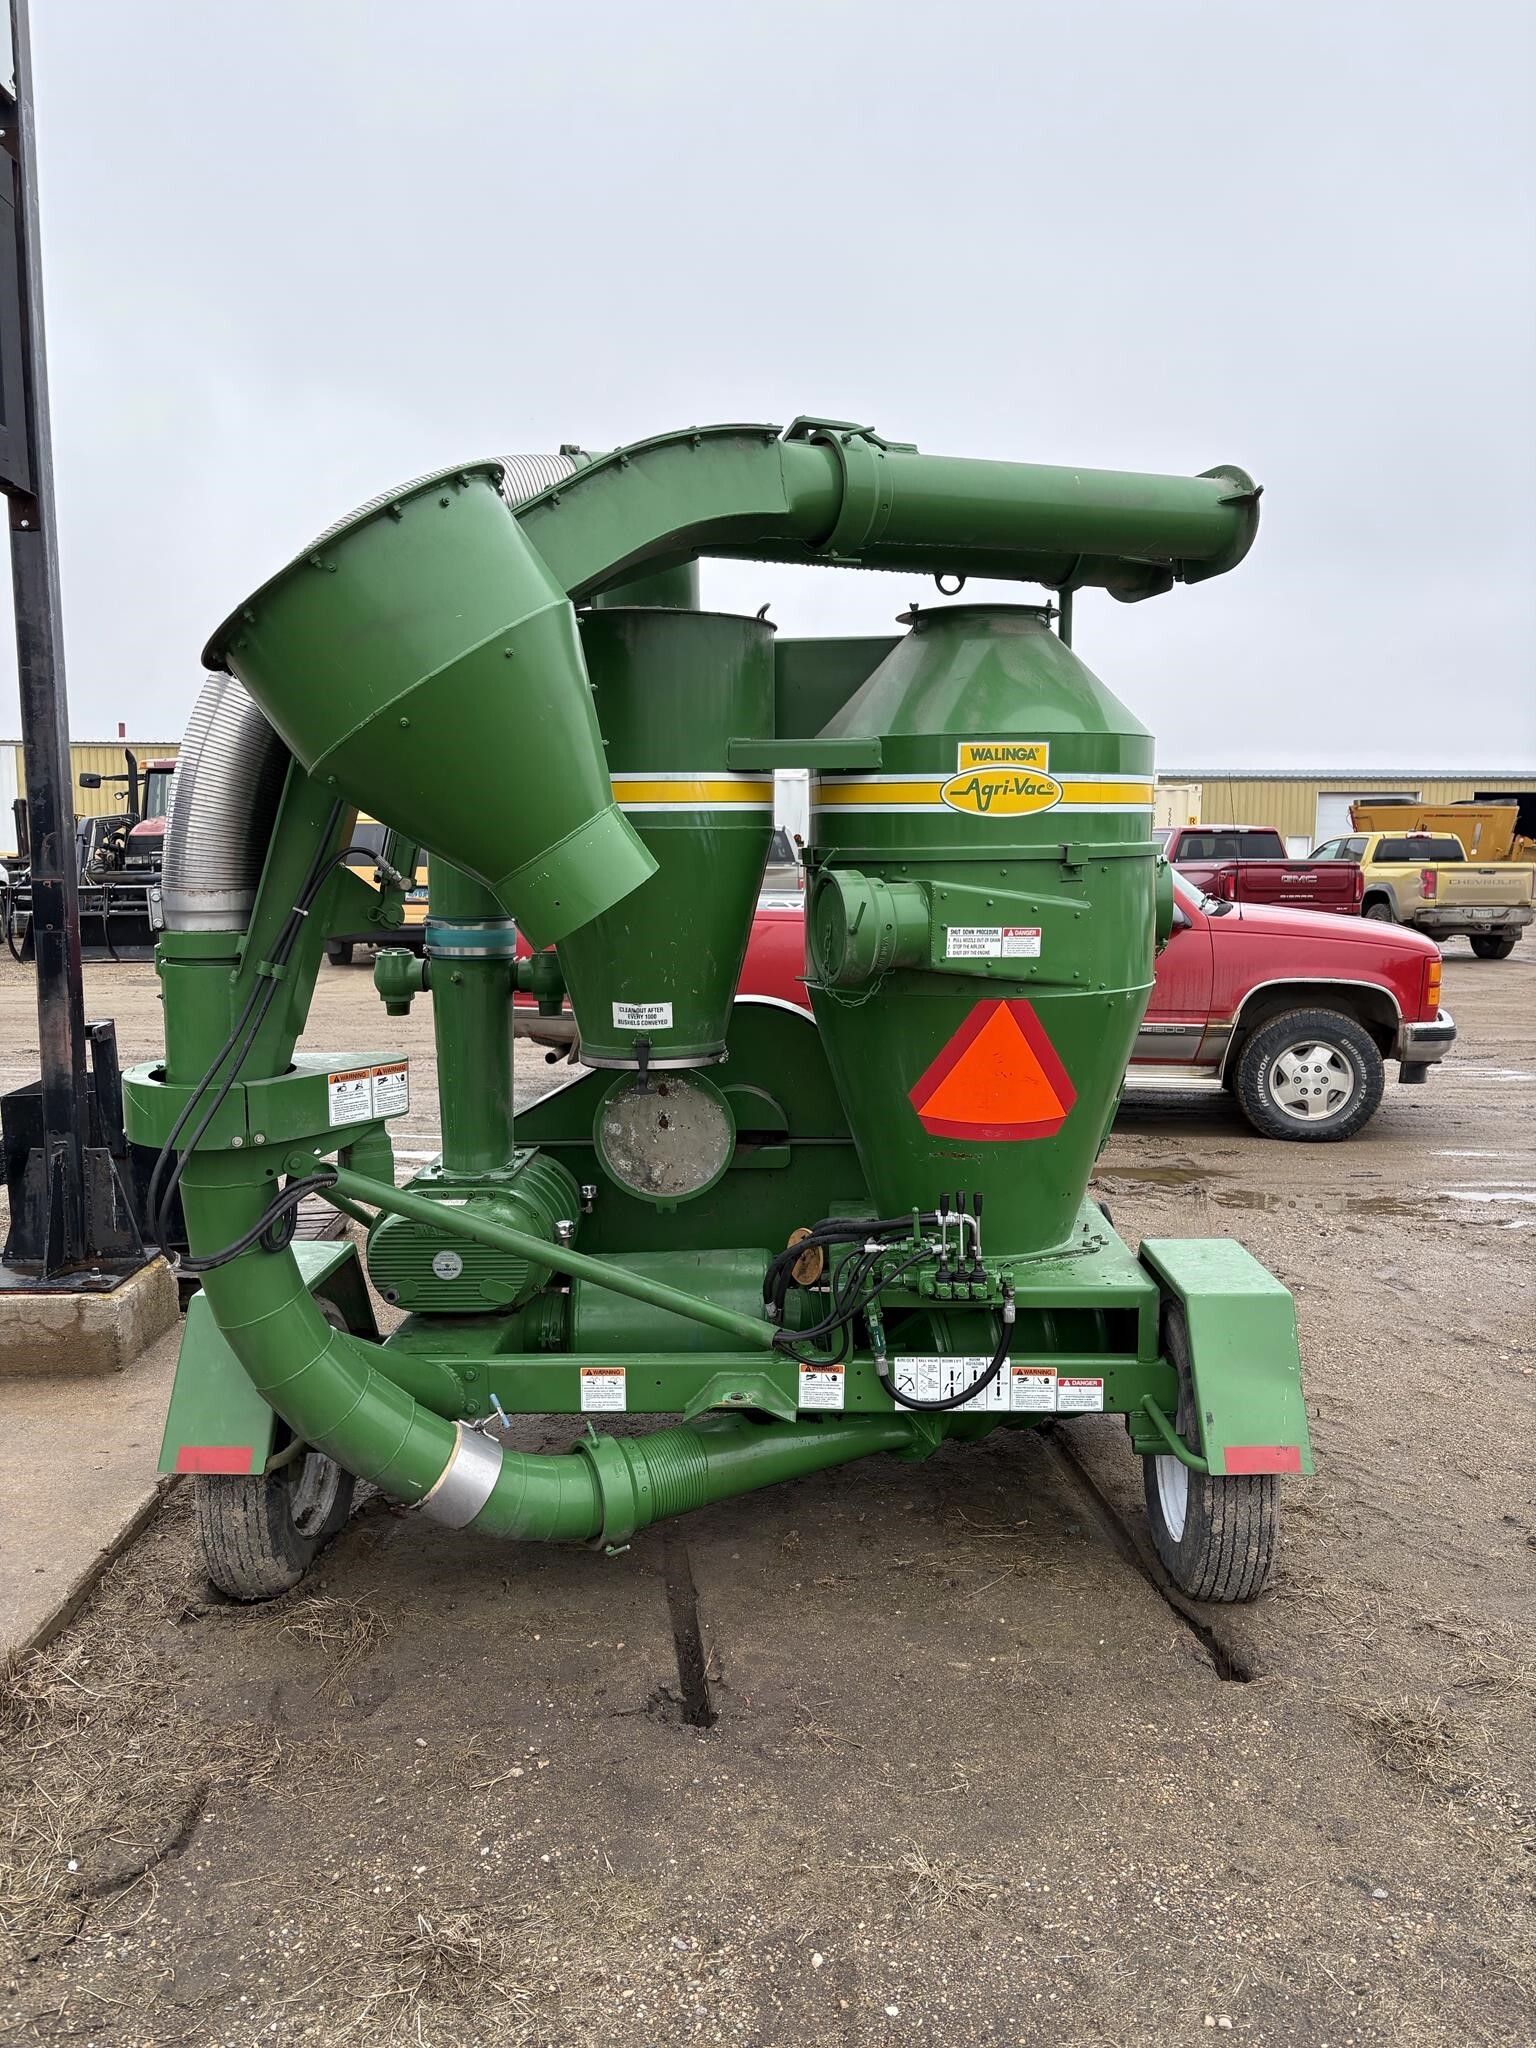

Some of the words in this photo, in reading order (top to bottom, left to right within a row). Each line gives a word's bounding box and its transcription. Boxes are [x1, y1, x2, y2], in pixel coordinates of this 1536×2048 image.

[1189, 817, 1196, 825] R
[1281, 875, 1318, 883] GMC
[1153, 1026, 1186, 1034] 1500
[383, 1064, 406, 1074] WARNING
[340, 1071, 367, 1081] WARNING
